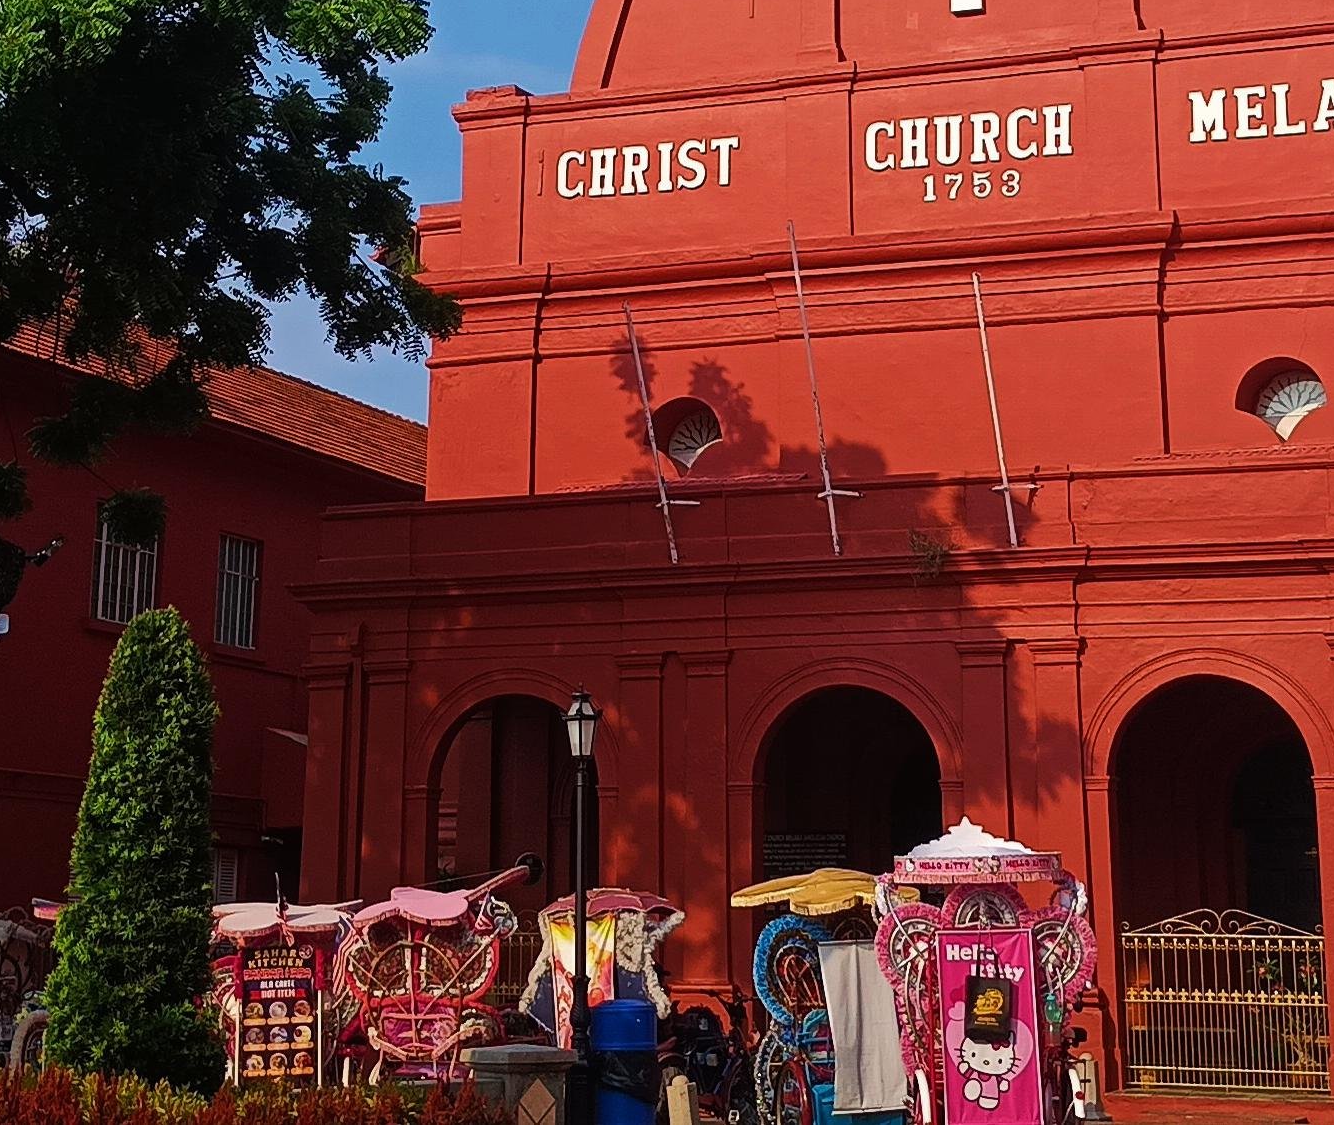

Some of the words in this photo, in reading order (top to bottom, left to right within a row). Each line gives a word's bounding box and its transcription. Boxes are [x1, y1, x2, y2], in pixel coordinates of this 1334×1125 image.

[558, 137, 738, 197] CHRIST
[866, 105, 1072, 170] CHURCH
[924, 170, 1019, 201] 1753
[919, 861, 942, 870] HELLO
[945, 861, 970, 870] KITTY
[1005, 859, 1030, 868] HELLO
[254, 949, 297, 959] SAHAR
[248, 958, 304, 968] KITCHEN
